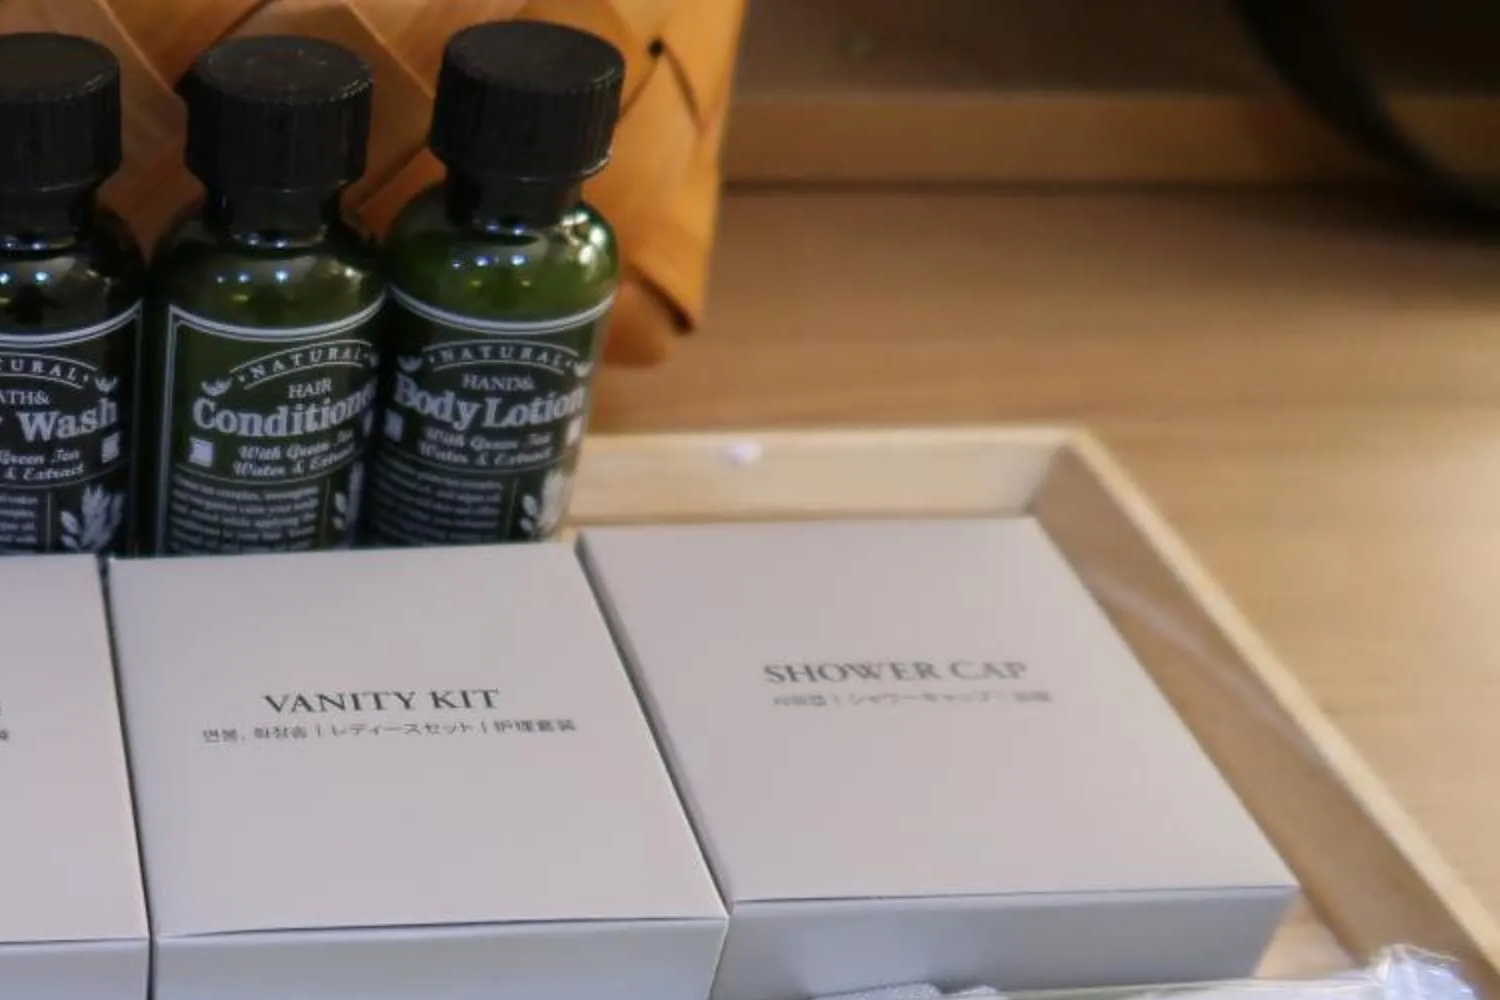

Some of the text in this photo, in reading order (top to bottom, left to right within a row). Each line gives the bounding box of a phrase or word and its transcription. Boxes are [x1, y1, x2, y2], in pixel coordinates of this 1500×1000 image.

[441, 345, 565, 367] NATURAL
[288, 377, 333, 399] HAIR
[192, 378, 378, 438] Condition
[395, 373, 586, 431] Body Lotion
[15, 397, 118, 443] Wash
[763, 660, 1029, 683] SHOWER CAP
[261, 688, 501, 714] VANITY KIT
